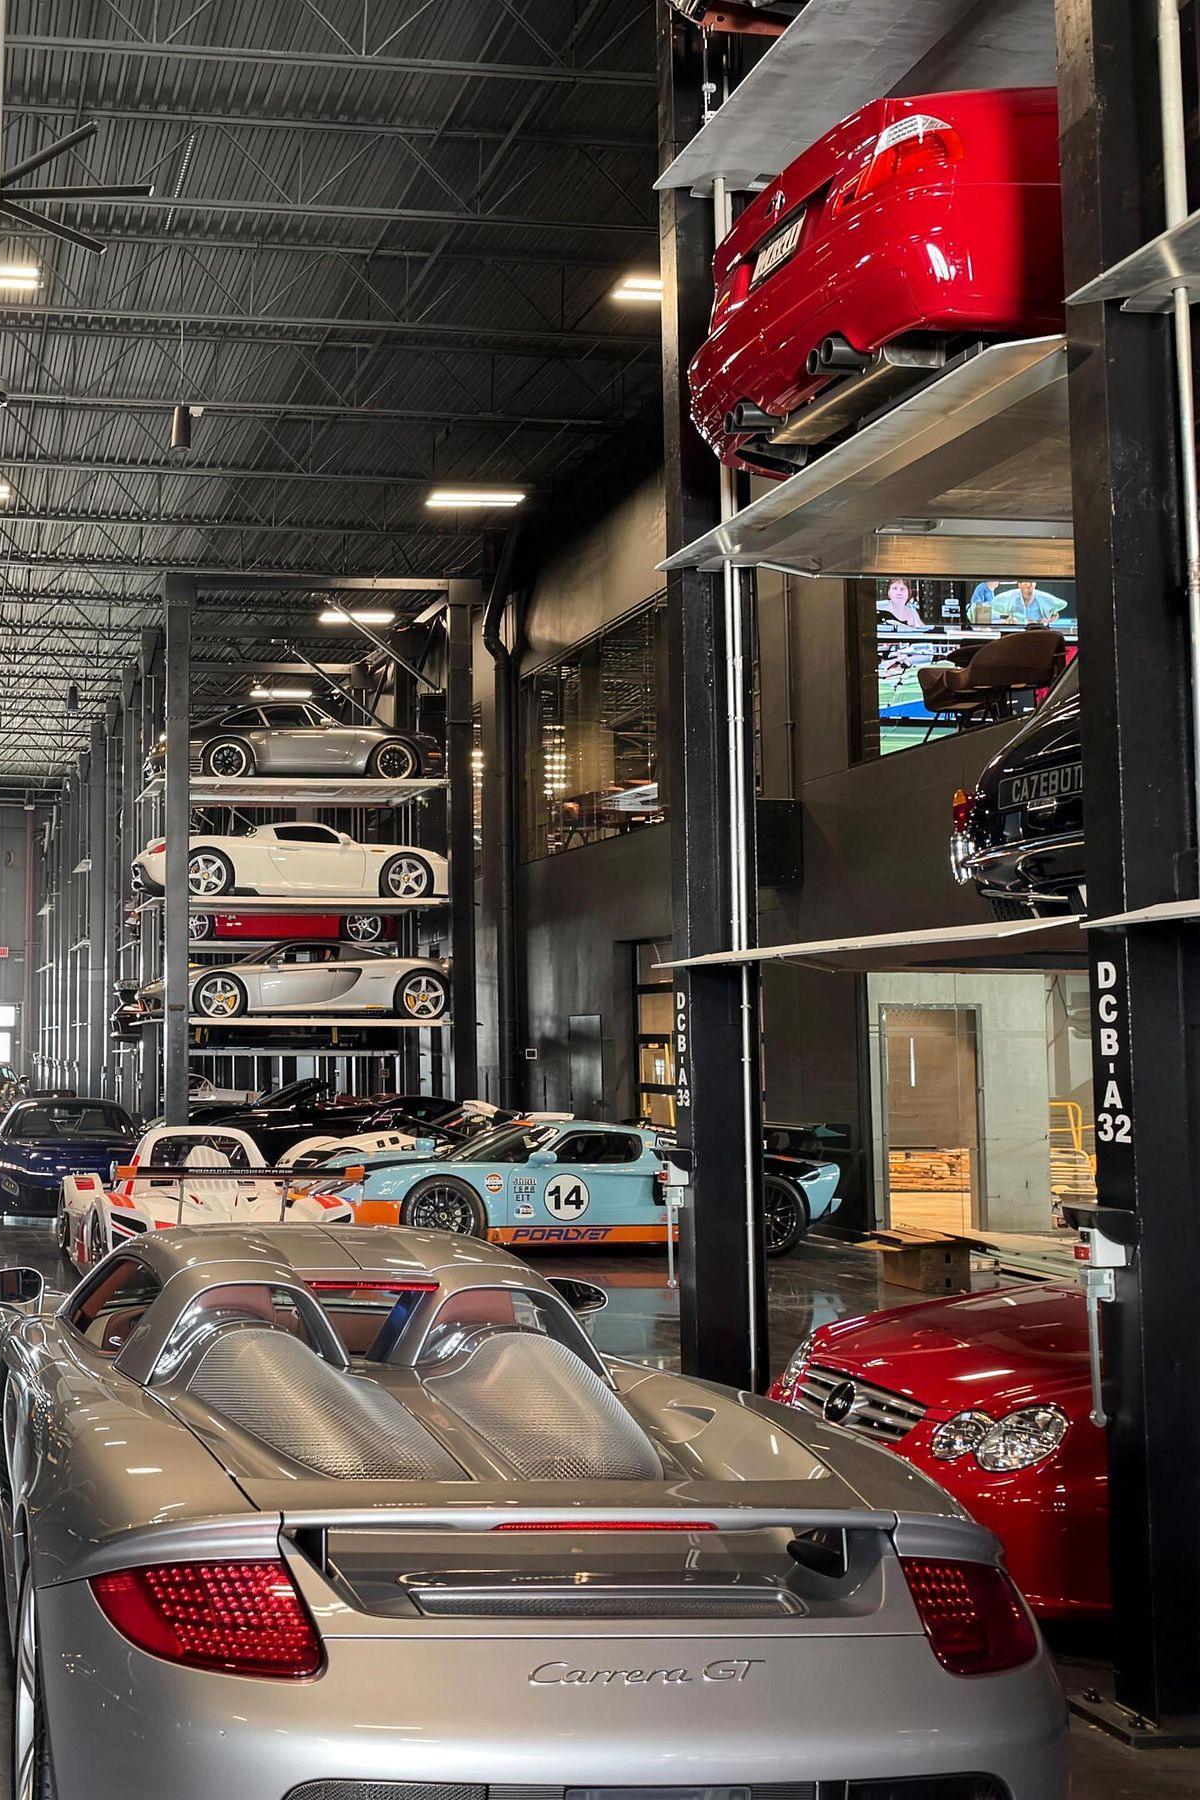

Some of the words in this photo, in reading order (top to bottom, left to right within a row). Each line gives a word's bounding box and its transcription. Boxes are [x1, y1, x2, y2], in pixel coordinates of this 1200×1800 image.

[547, 1185, 584, 1210] 14
[528, 1661, 693, 1684] Carrera
[703, 1659, 766, 1682] GT
